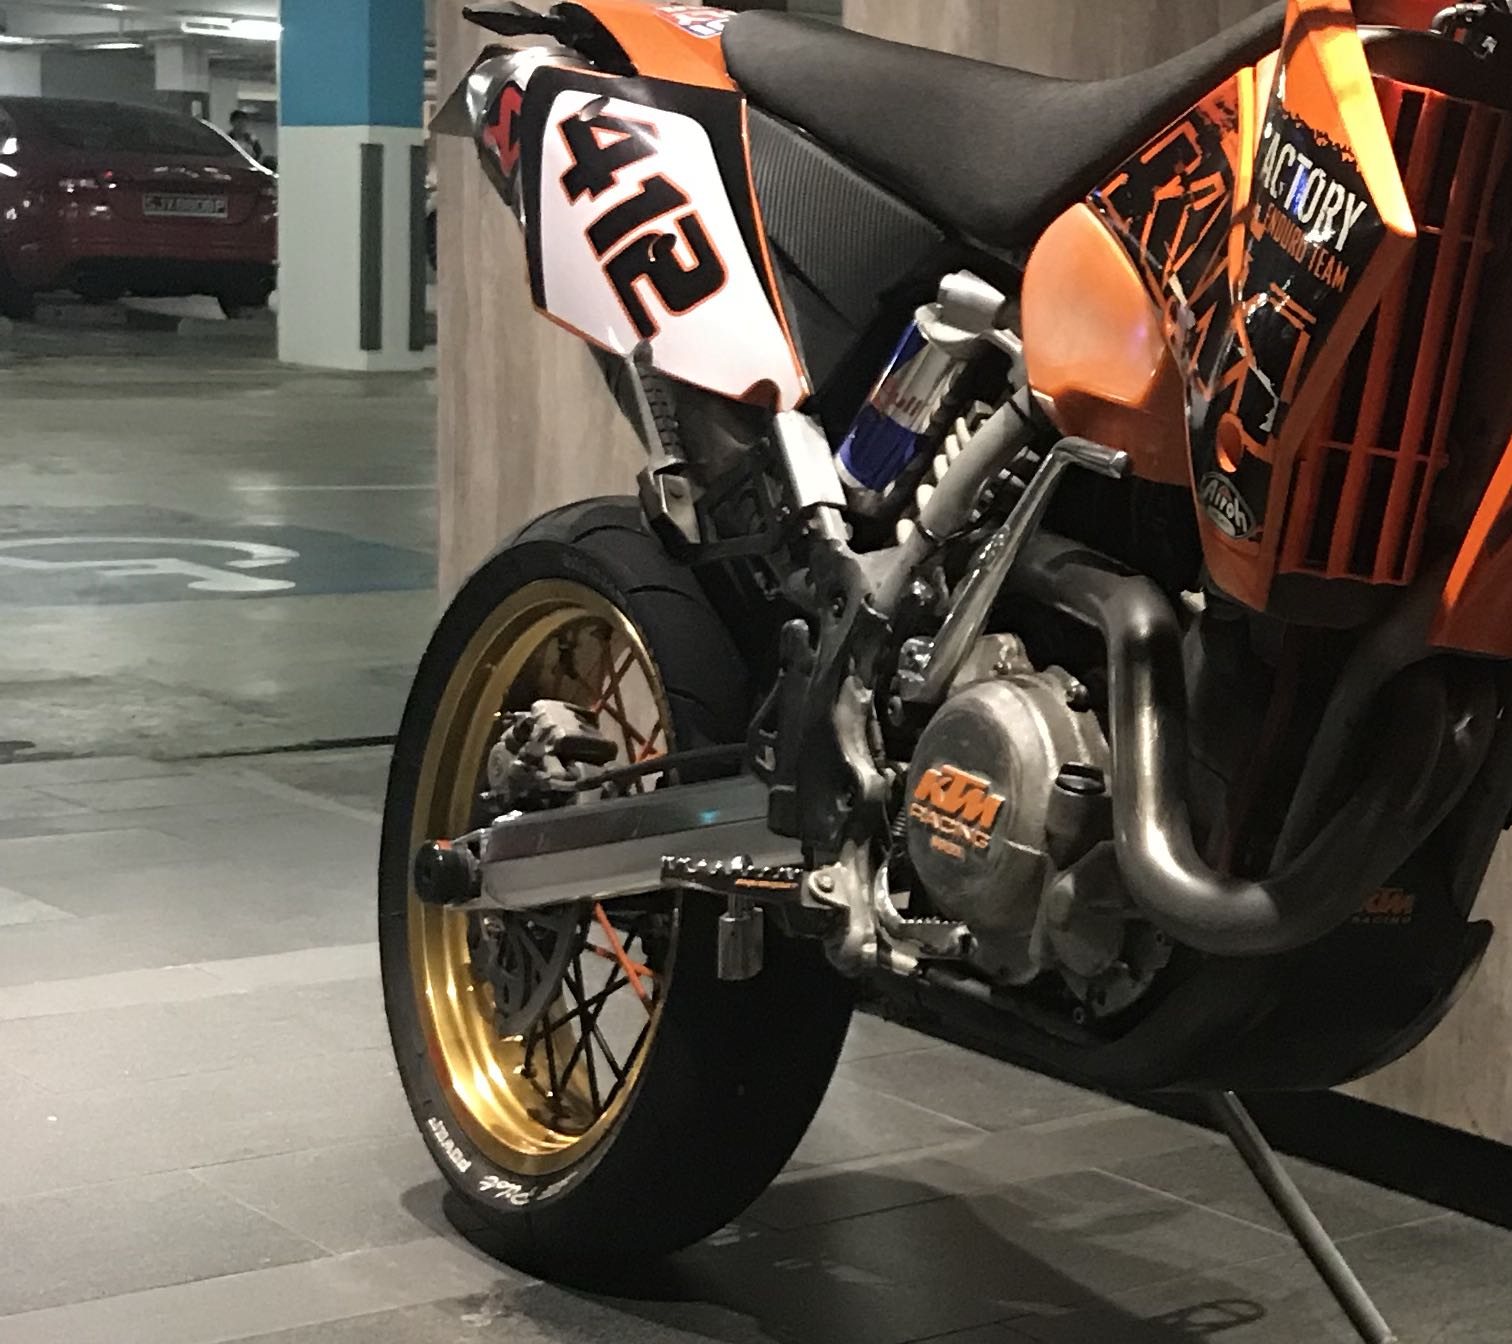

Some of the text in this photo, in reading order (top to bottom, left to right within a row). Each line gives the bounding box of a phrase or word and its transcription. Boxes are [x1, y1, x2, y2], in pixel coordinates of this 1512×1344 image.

[556, 112, 728, 340] 412
[1308, 244, 1349, 292] TEAM
[914, 763, 1005, 830] KTM
[909, 802, 992, 849] RACING
